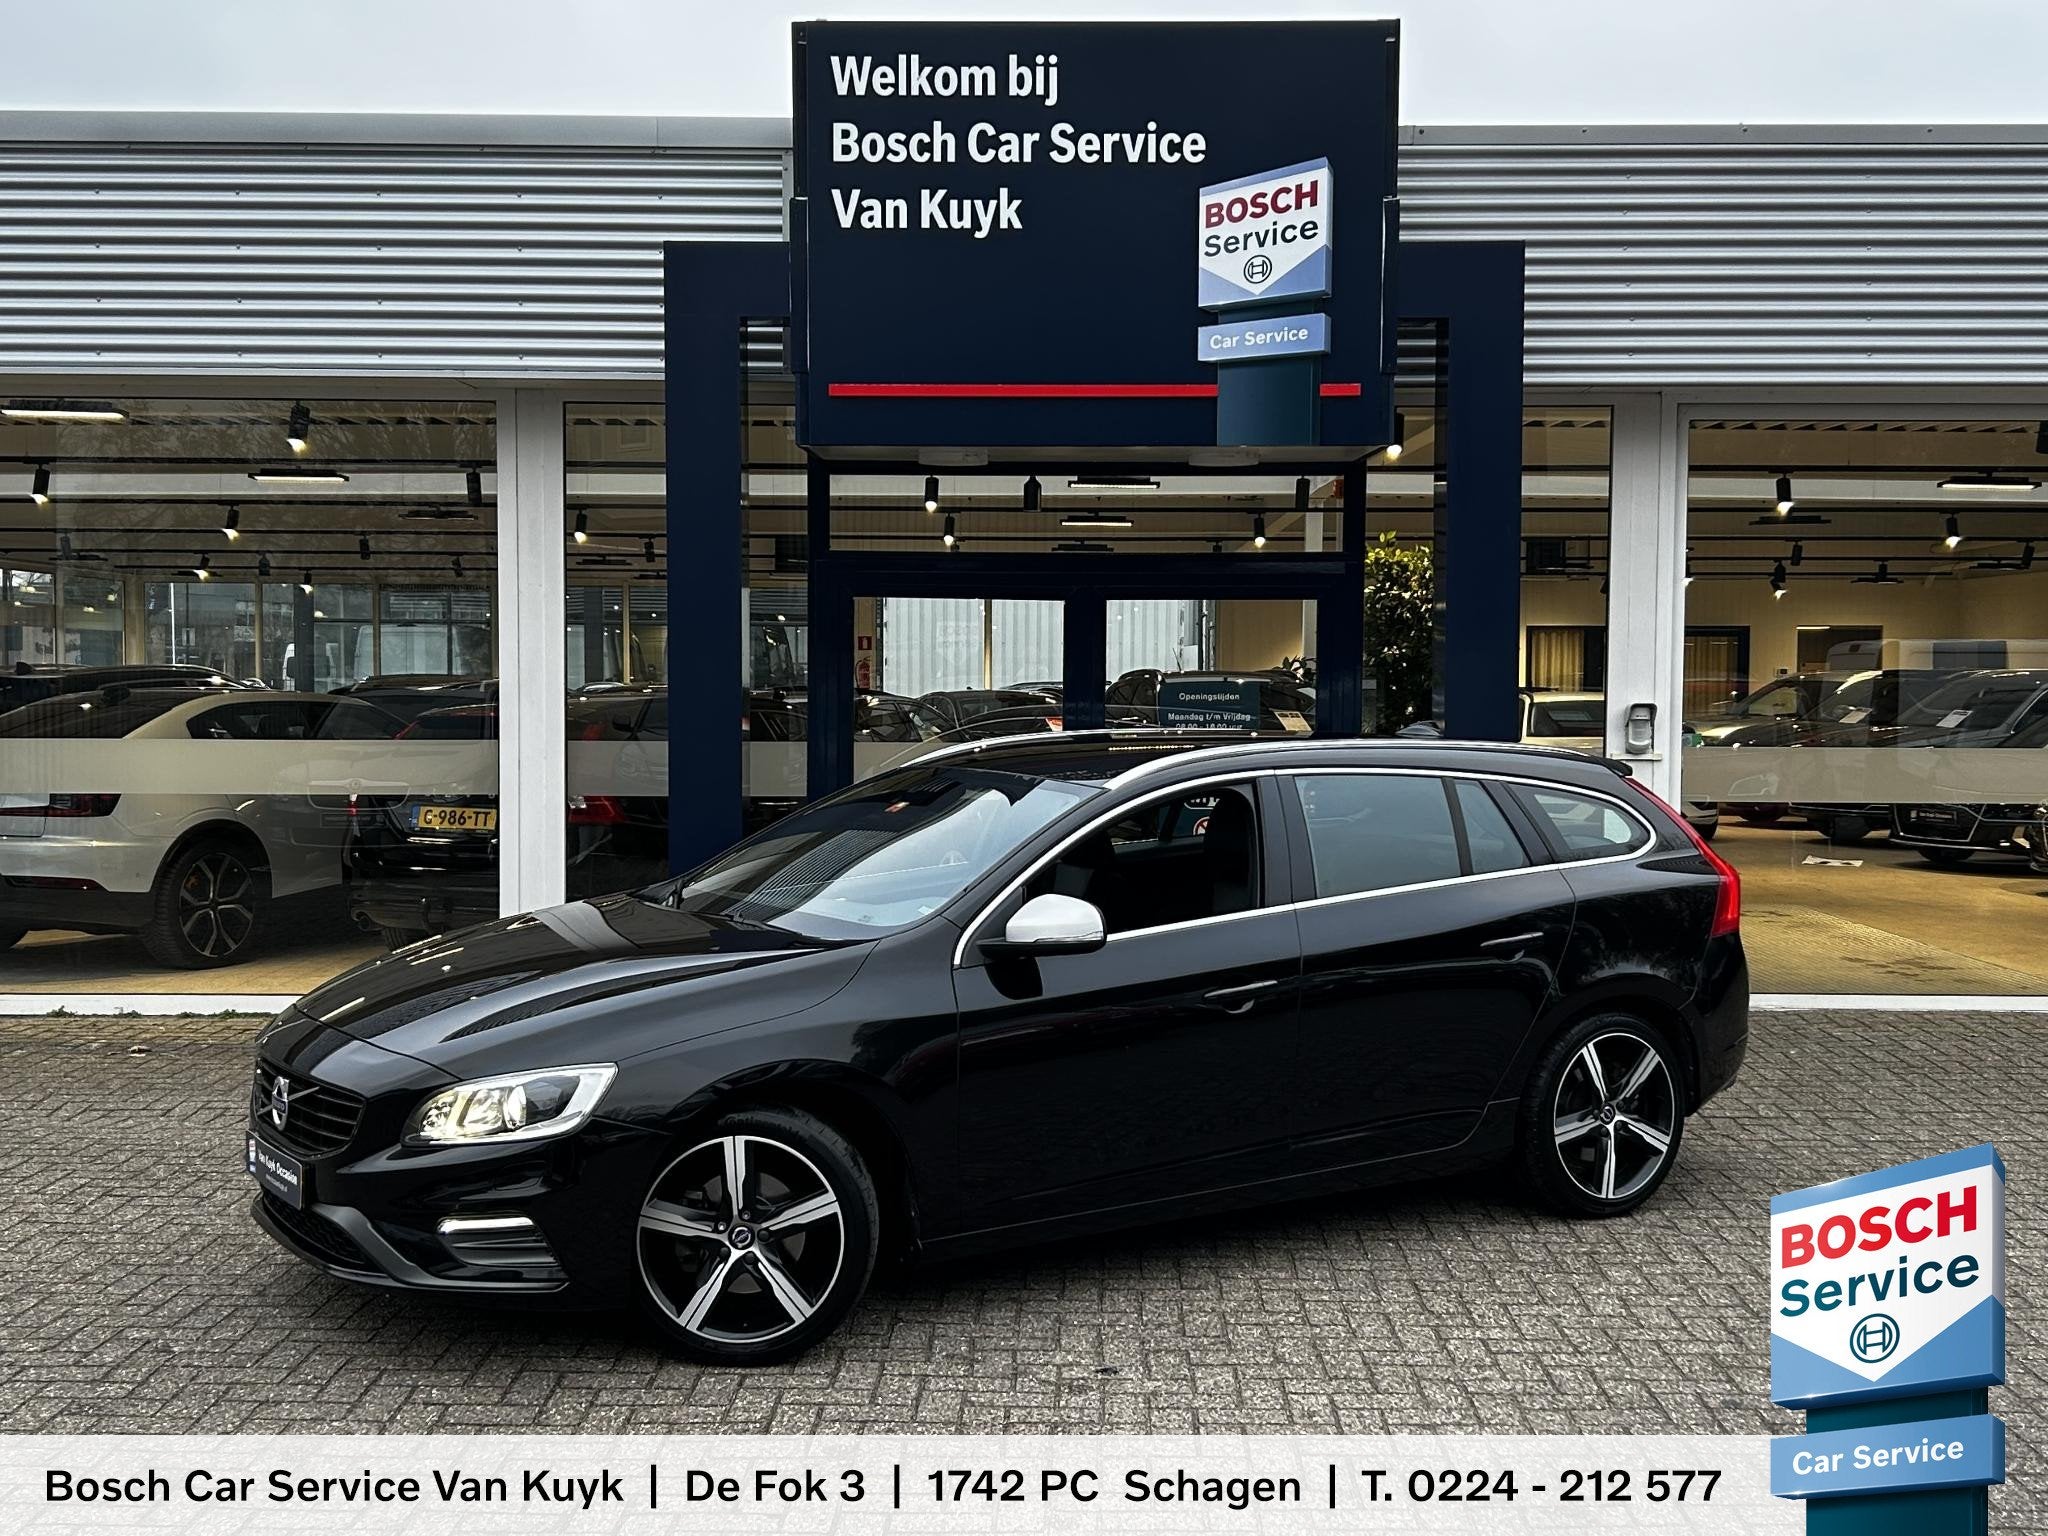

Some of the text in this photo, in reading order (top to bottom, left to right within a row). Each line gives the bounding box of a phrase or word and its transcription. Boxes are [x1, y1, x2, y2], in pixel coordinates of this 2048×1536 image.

[831, 54, 1058, 106] Welkom bij
[832, 121, 1207, 164] Bosch Car Service
[832, 188, 1023, 238] Van Kuyk
[1205, 180, 1318, 228] BOSCH
[1204, 220, 1318, 257] Service
[1210, 326, 1309, 349] Car Service
[1178, 692, 1240, 701] Openingstijden
[1167, 712, 1251, 721] Maandag t/m Vrijdag
[424, 809, 491, 827] G-986-TT
